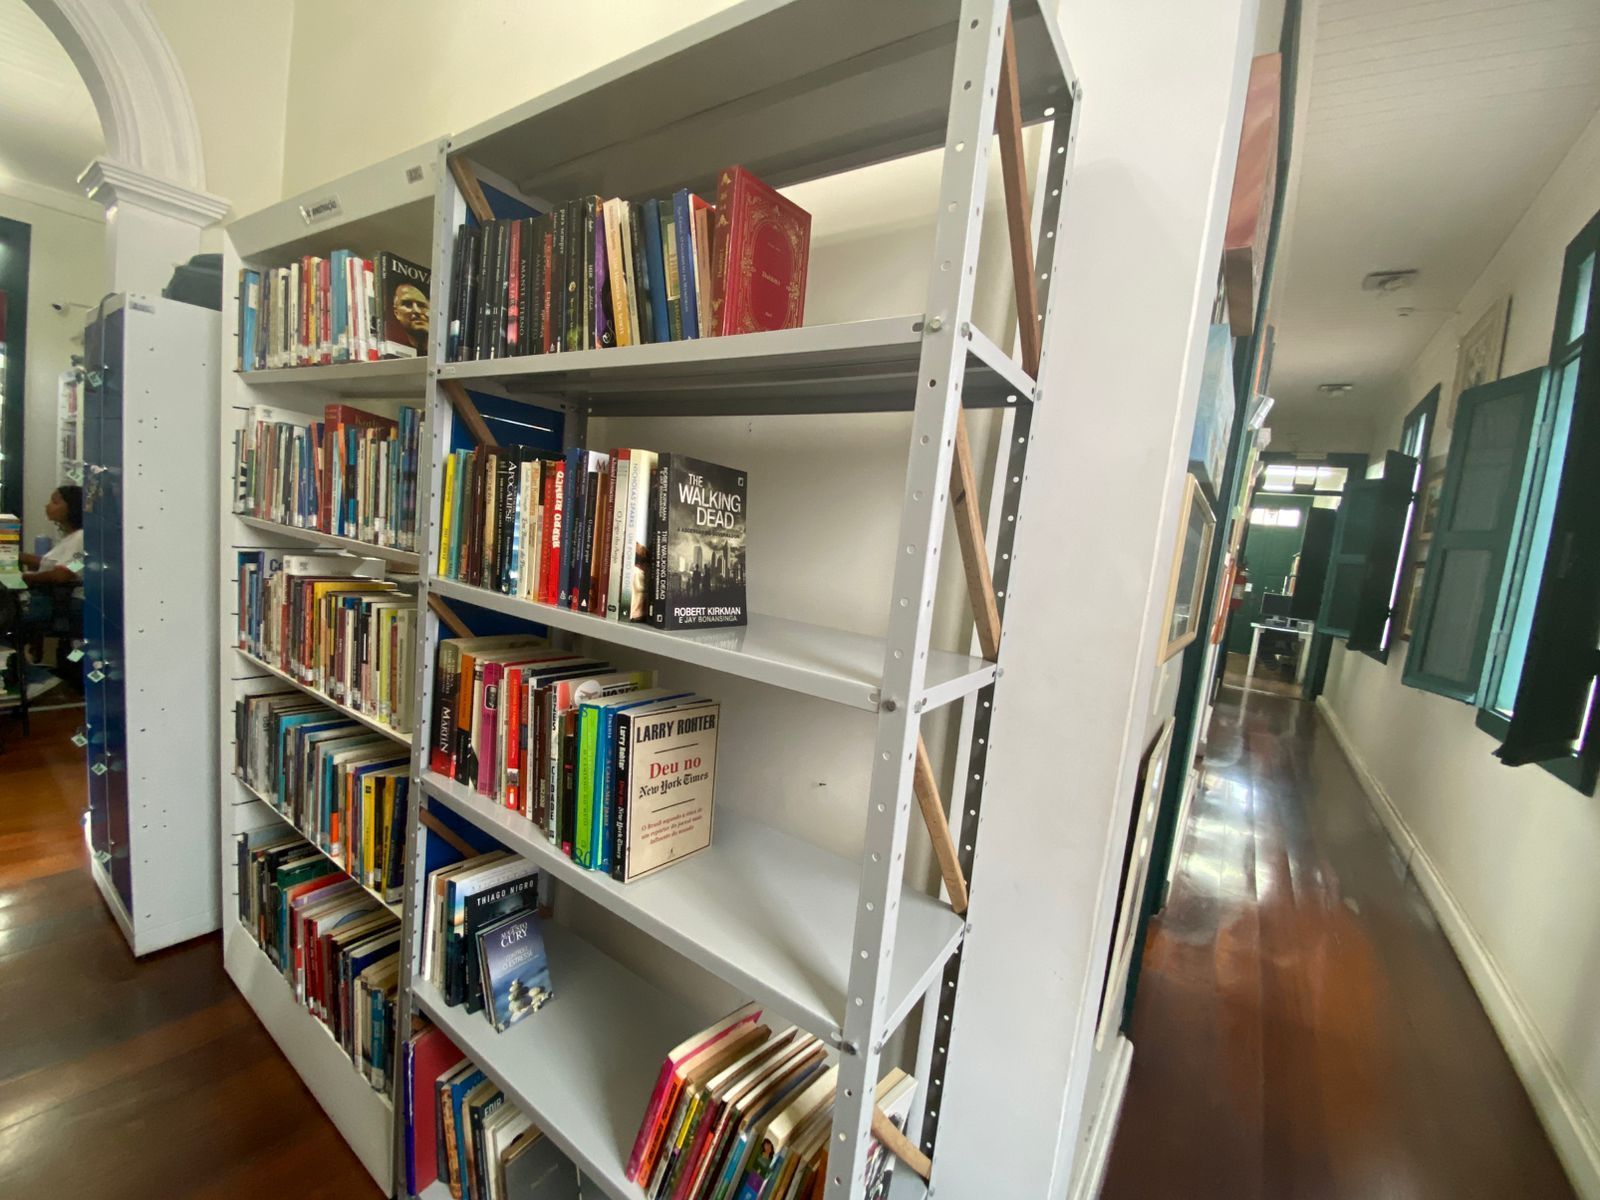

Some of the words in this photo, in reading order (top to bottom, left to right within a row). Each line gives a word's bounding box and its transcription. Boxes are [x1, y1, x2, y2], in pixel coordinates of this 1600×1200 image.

[518, 300, 526, 337] ETERNO
[505, 460, 517, 523] APOCALIPSE
[629, 462, 638, 502] NICHOLAS
[688, 473, 703, 487] THE
[678, 483, 741, 513] WALKING
[614, 518, 622, 535] Jogo
[627, 503, 636, 528] SPARKS
[696, 506, 735, 529] DEAD
[674, 607, 705, 617] ROBERT
[707, 606, 741, 616] KIRKMAN
[698, 615, 738, 623] BONANSINGA
[440, 706, 451, 753] MARTIN
[619, 725, 627, 745] Larry
[636, 720, 675, 744] LARRY
[676, 713, 716, 736] ROHTER
[618, 746, 626, 770] Rohter
[649, 761, 679, 779] Deu
[684, 756, 702, 770] no
[638, 785, 659, 799] New
[660, 777, 682, 796] York
[683, 771, 709, 786] Times
[617, 806, 625, 820] New
[648, 821, 662, 830] Brasil
[662, 815, 681, 826] segundo
[677, 819, 692, 829] jornal
[616, 821, 624, 838] York
[678, 825, 695, 836] mundo
[476, 889, 507, 907] THIAGO
[510, 880, 535, 895] NIGRO
[500, 927, 529, 948] CURY
